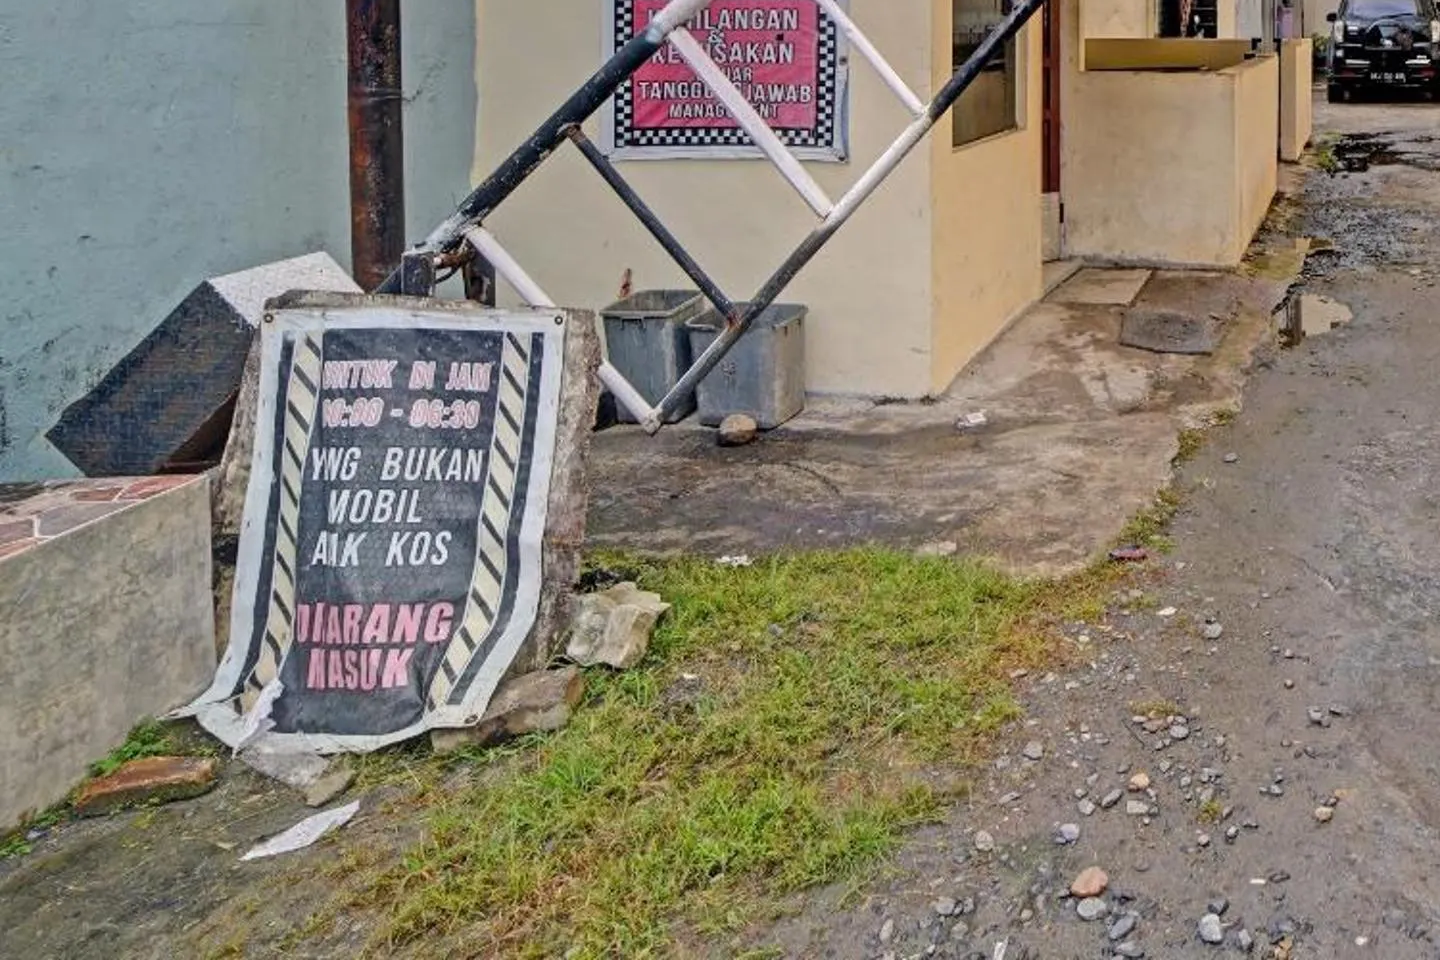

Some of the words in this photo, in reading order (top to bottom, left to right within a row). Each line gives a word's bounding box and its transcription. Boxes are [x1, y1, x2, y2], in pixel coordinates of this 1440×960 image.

[648, 9, 798, 30] ILANGAN
[408, 361, 437, 390] DI
[445, 361, 493, 392] JAM
[380, 447, 485, 483] BUKAN
[385, 531, 452, 567] KOS
